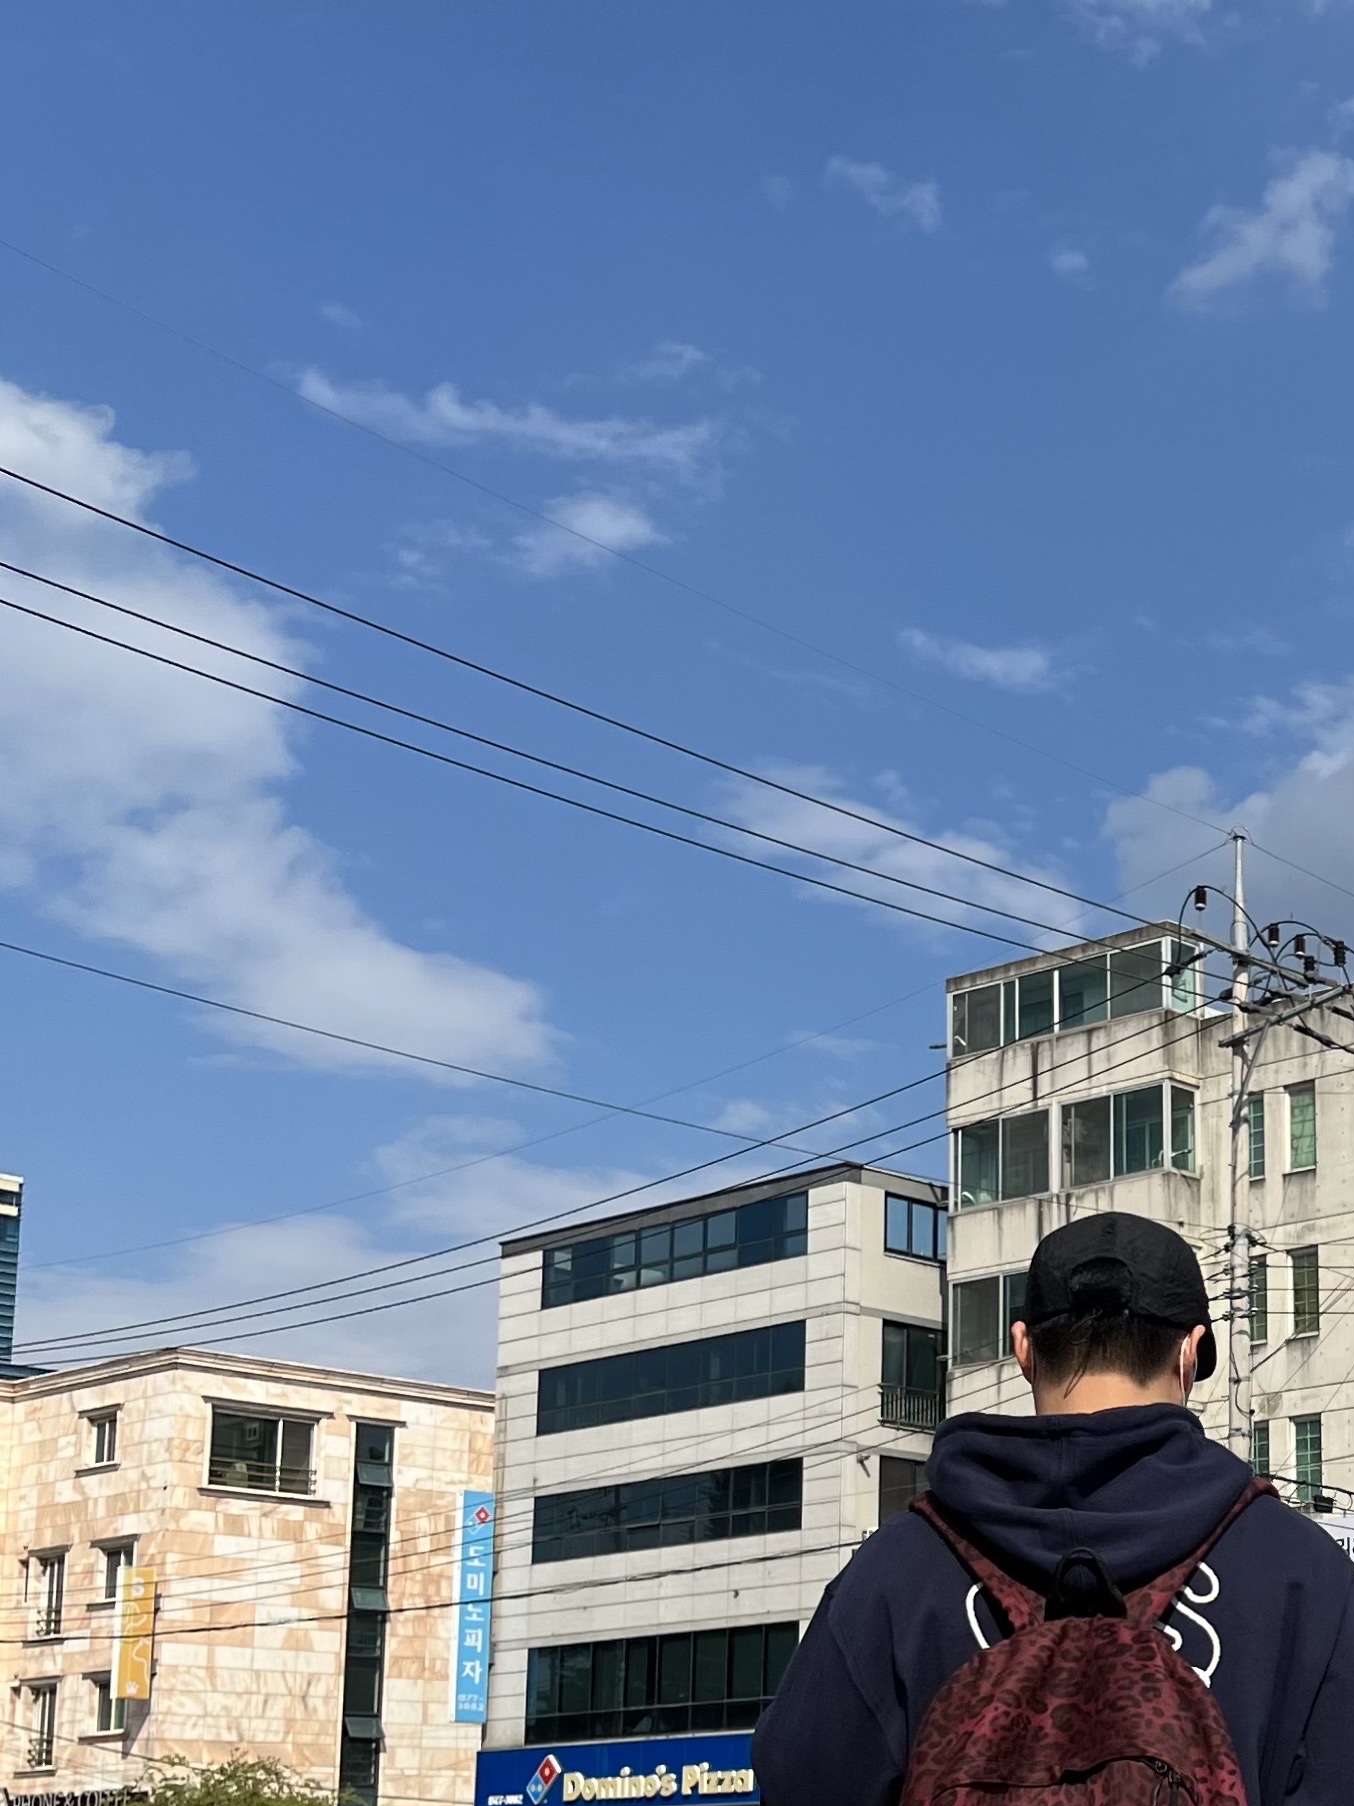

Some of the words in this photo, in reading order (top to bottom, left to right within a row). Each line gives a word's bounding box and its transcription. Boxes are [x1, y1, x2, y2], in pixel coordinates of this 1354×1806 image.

[461, 1546, 486, 1684] 도미노피자
[563, 1766, 677, 1802] Domino's
[681, 1762, 754, 1796] Pizza
